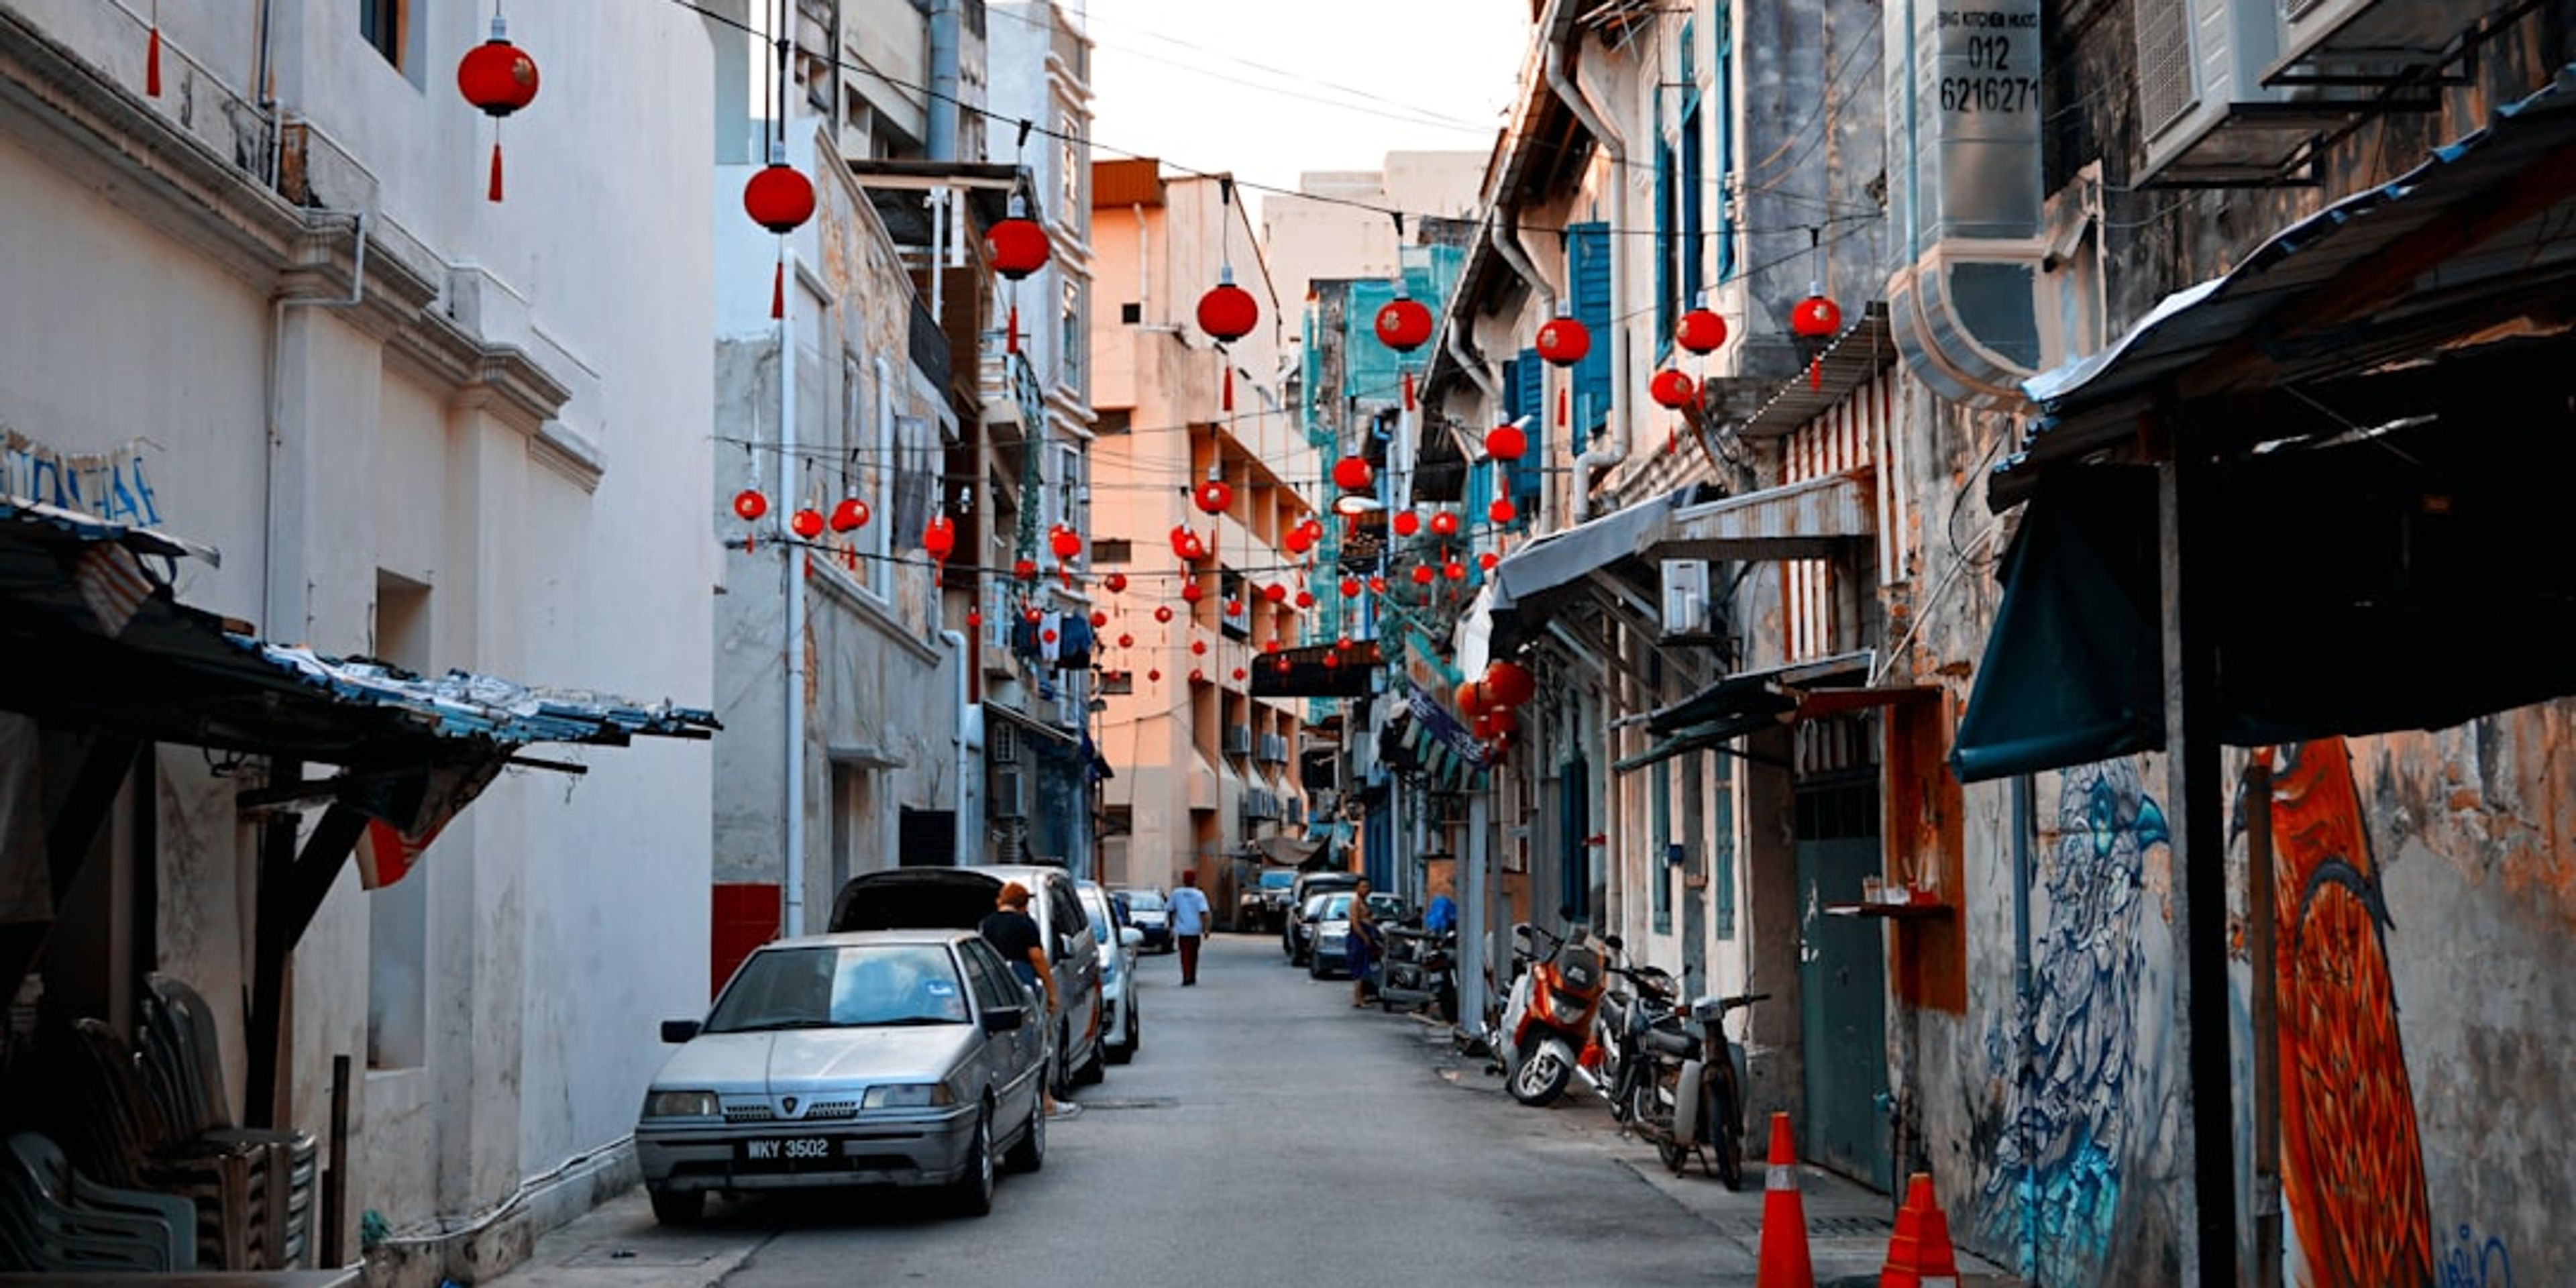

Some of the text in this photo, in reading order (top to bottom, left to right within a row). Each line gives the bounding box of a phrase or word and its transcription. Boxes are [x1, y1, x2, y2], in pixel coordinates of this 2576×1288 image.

[1969, 36, 2009, 70] 012
[1941, 78, 2038, 112] 6216271
[748, 1139, 828, 1159] WKY 3502
